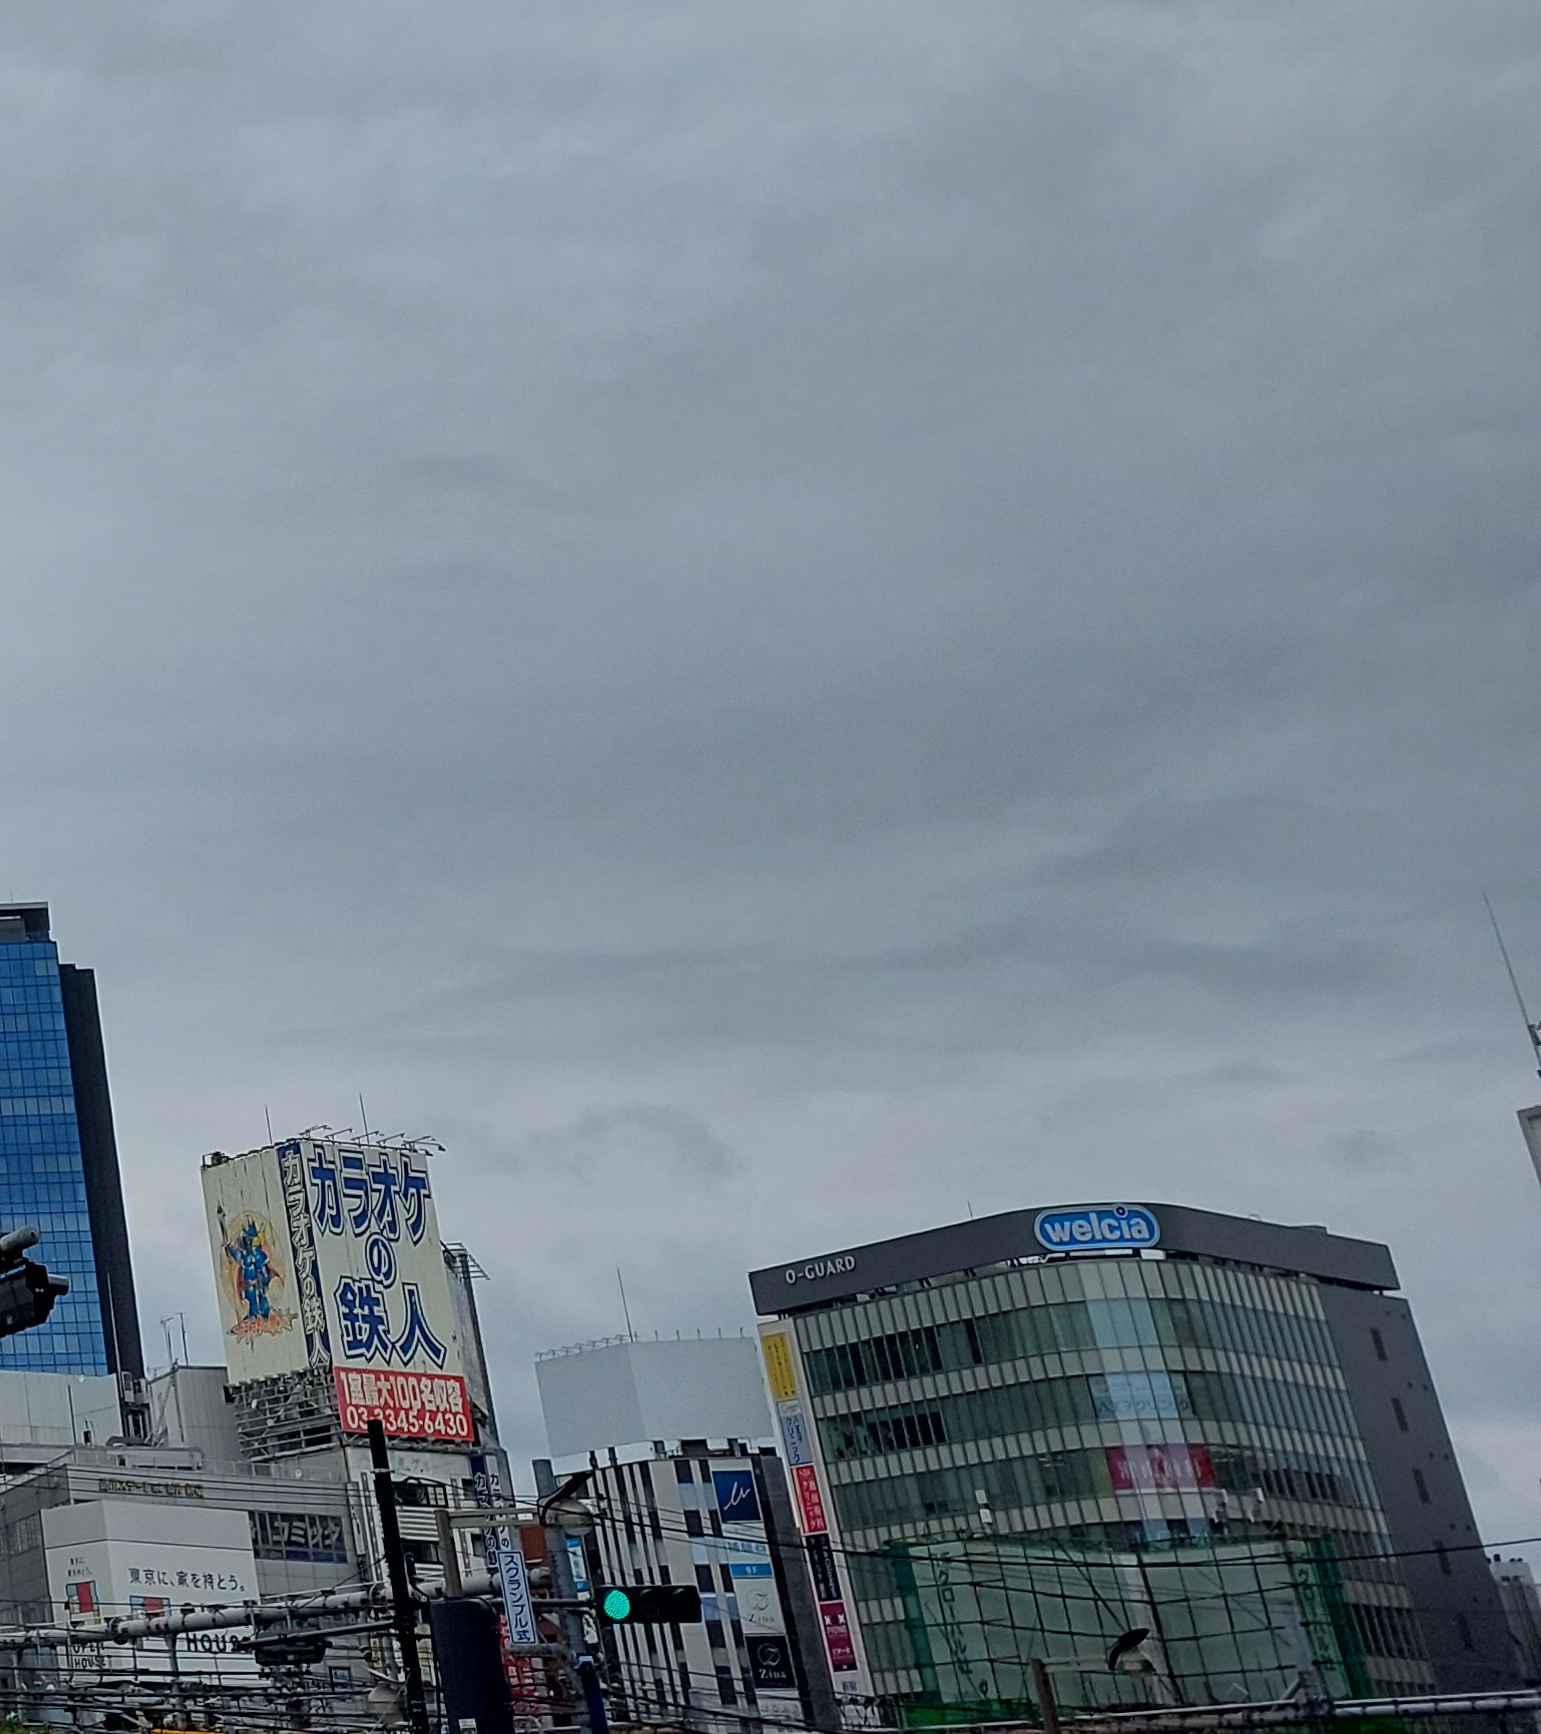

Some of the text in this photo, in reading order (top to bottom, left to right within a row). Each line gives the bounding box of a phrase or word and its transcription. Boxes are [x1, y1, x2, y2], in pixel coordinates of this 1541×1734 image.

[307, 1143, 433, 1248] カラオケ
[1044, 1206, 1150, 1243] welcia
[281, 1149, 331, 1369] カラオケの鉄人
[365, 1230, 398, 1290] の
[785, 1255, 856, 1284] O-GUARD
[333, 1274, 448, 1370] 鉄人
[340, 1370, 464, 1414] 1室最大100名収容
[504, 1554, 531, 1642] スクランブル式
